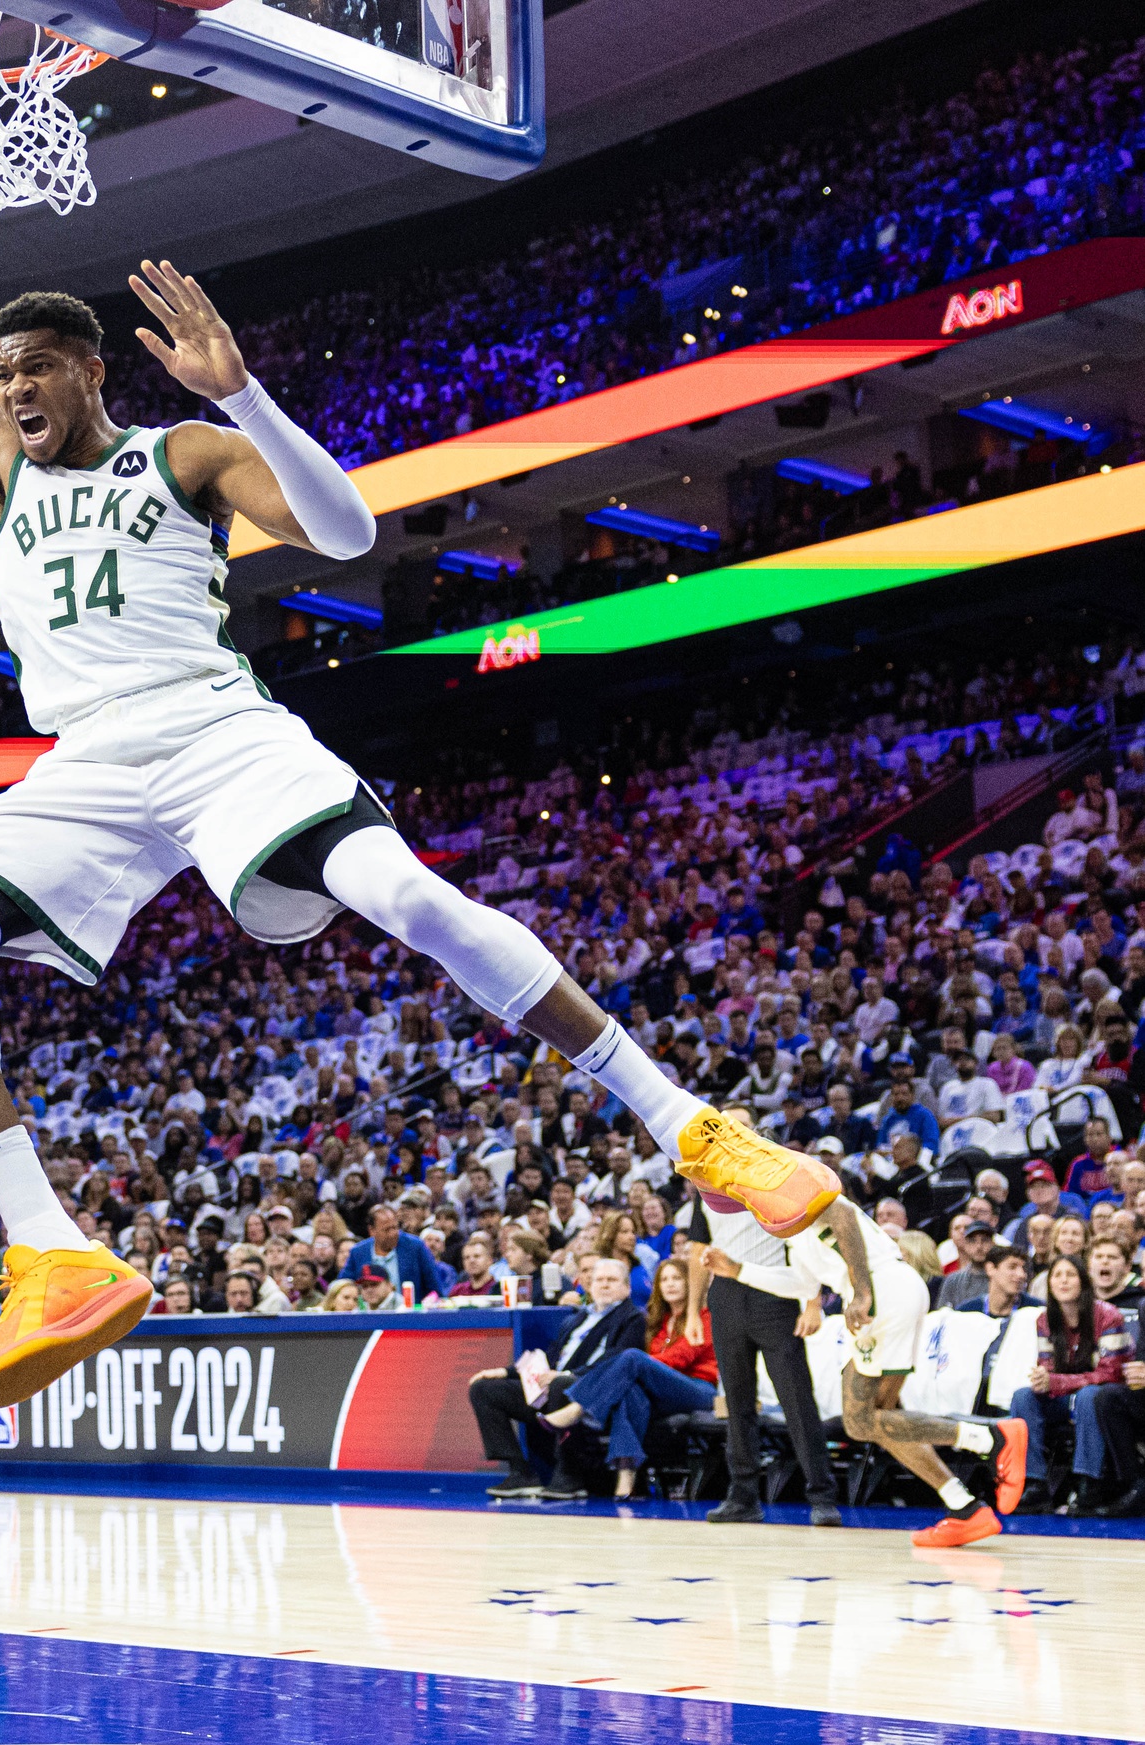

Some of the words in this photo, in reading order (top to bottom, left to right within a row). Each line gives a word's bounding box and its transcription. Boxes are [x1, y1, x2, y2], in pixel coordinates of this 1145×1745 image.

[429, 39, 450, 67] NBA
[941, 280, 1023, 335] AON
[11, 485, 168, 557] BUCKS
[43, 548, 127, 633] 34
[476, 628, 541, 674] AON
[168, 1346, 285, 1453] 2024
